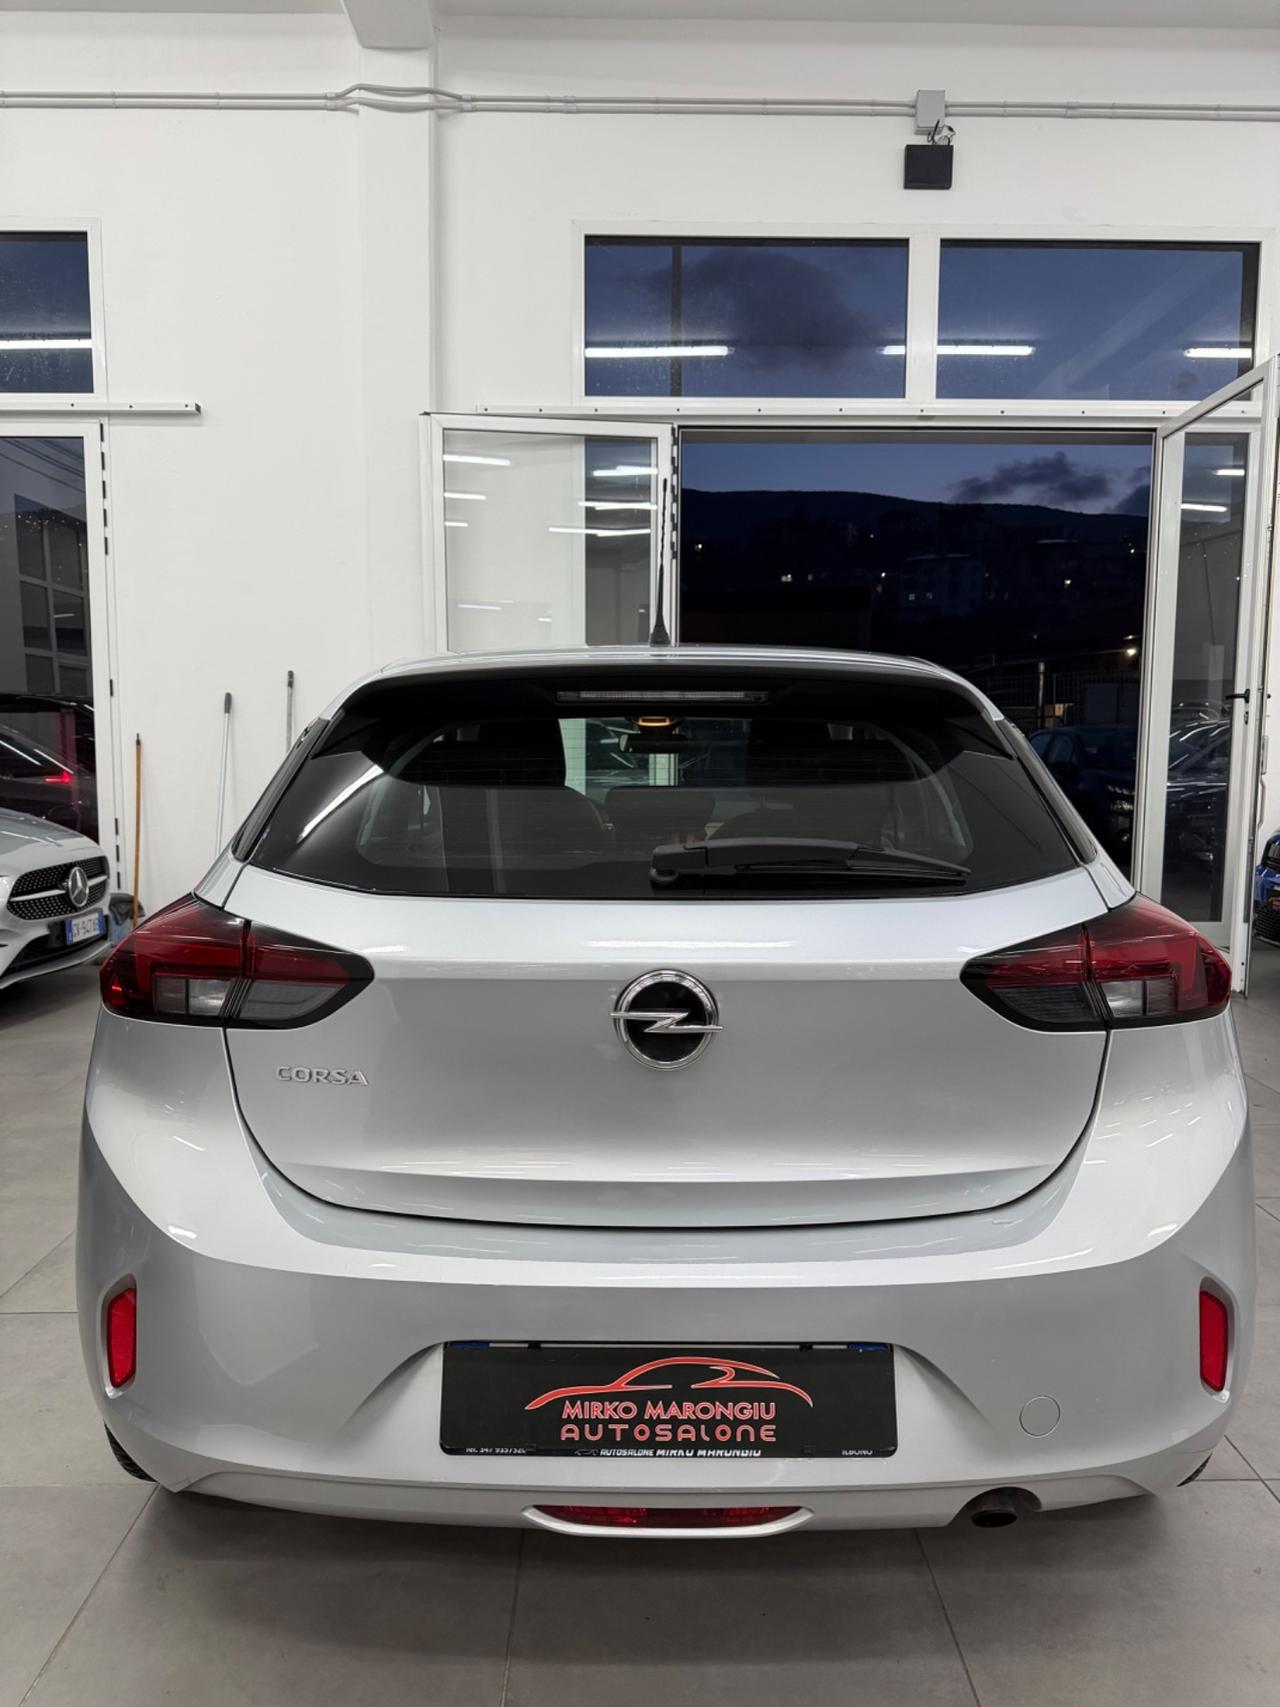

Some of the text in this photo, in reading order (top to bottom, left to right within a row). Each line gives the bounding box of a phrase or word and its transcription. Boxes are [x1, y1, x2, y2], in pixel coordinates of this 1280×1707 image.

[276, 1065, 369, 1086] CORSA
[561, 1400, 776, 1421] MIRKO MARONGIU
[560, 1423, 777, 1442] AUTOSALONE
